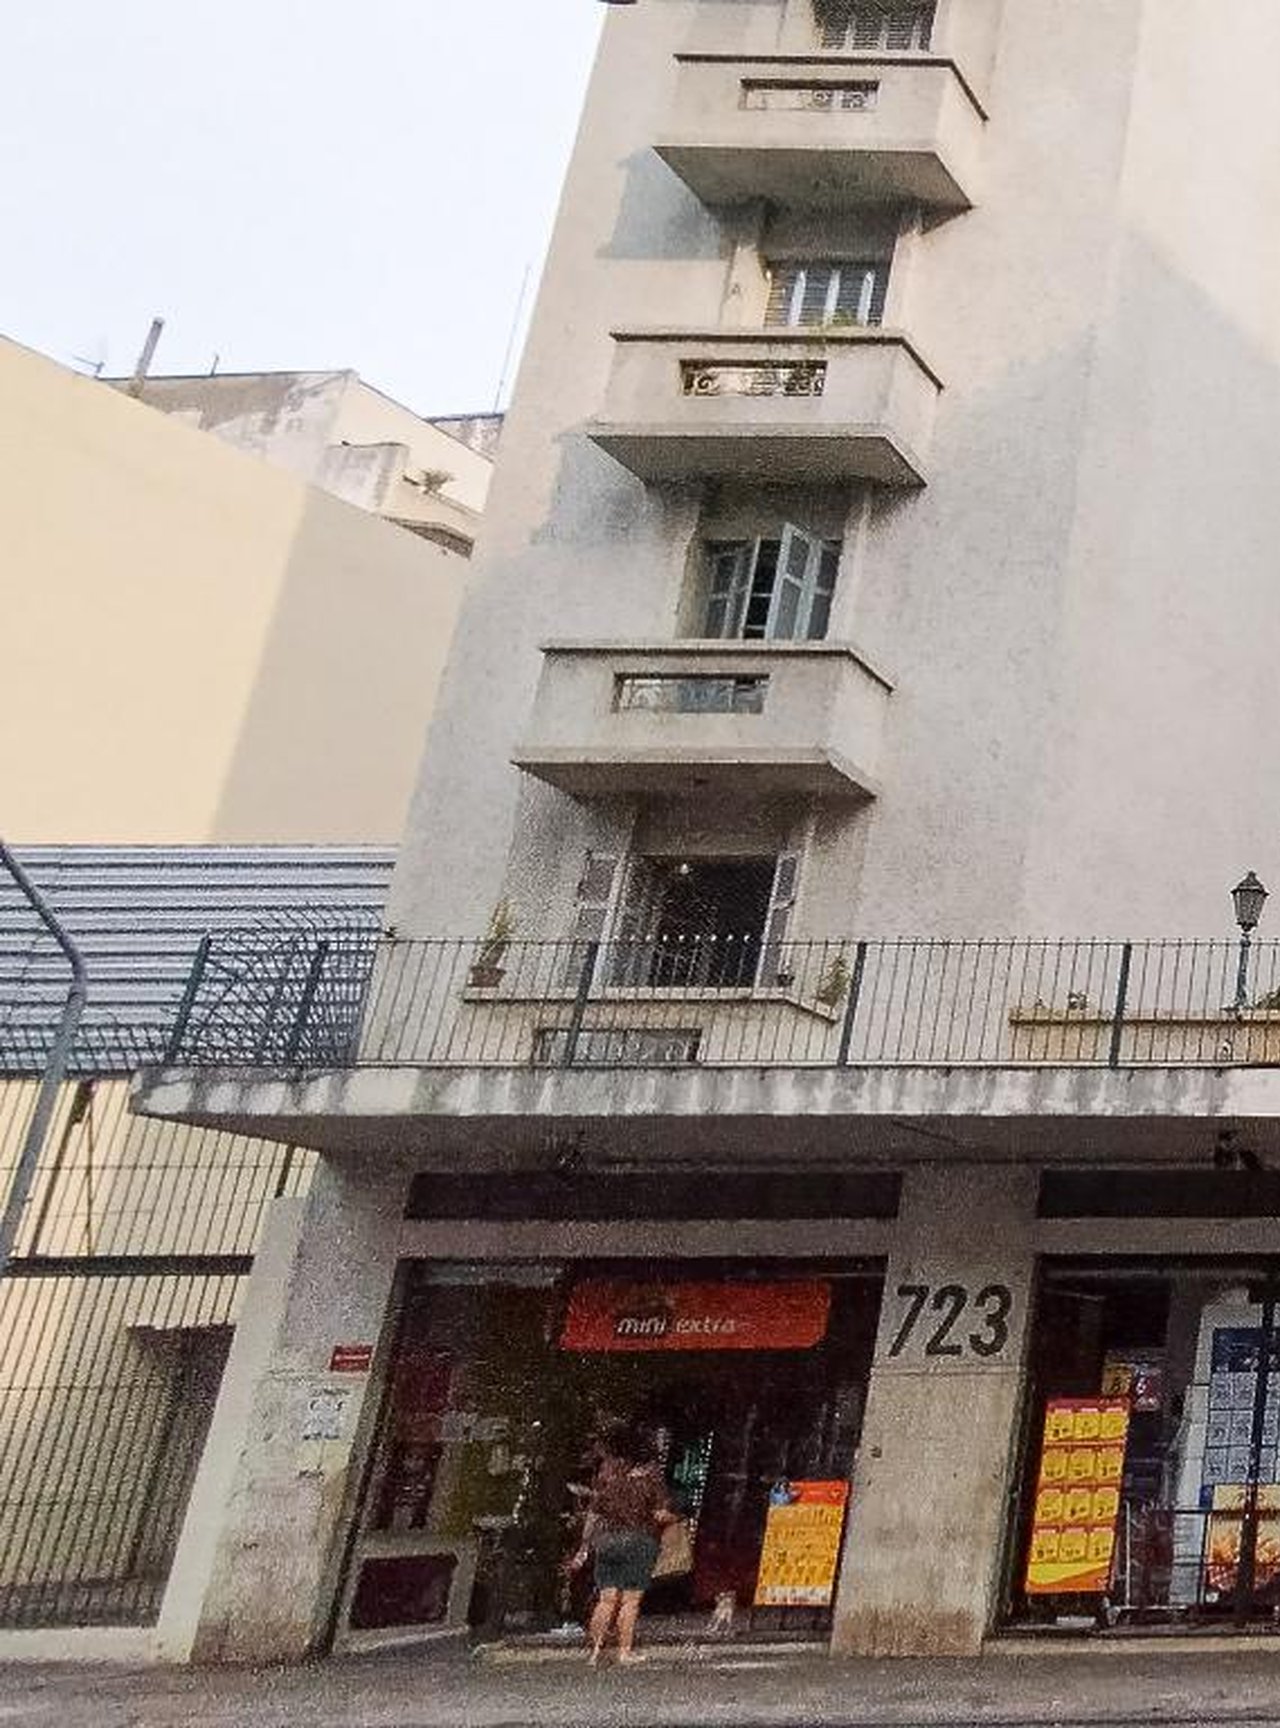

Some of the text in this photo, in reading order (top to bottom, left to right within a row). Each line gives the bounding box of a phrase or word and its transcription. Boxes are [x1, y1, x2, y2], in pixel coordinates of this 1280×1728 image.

[616, 1314, 737, 1335] mini extra
[888, 1284, 1014, 1358] 723
